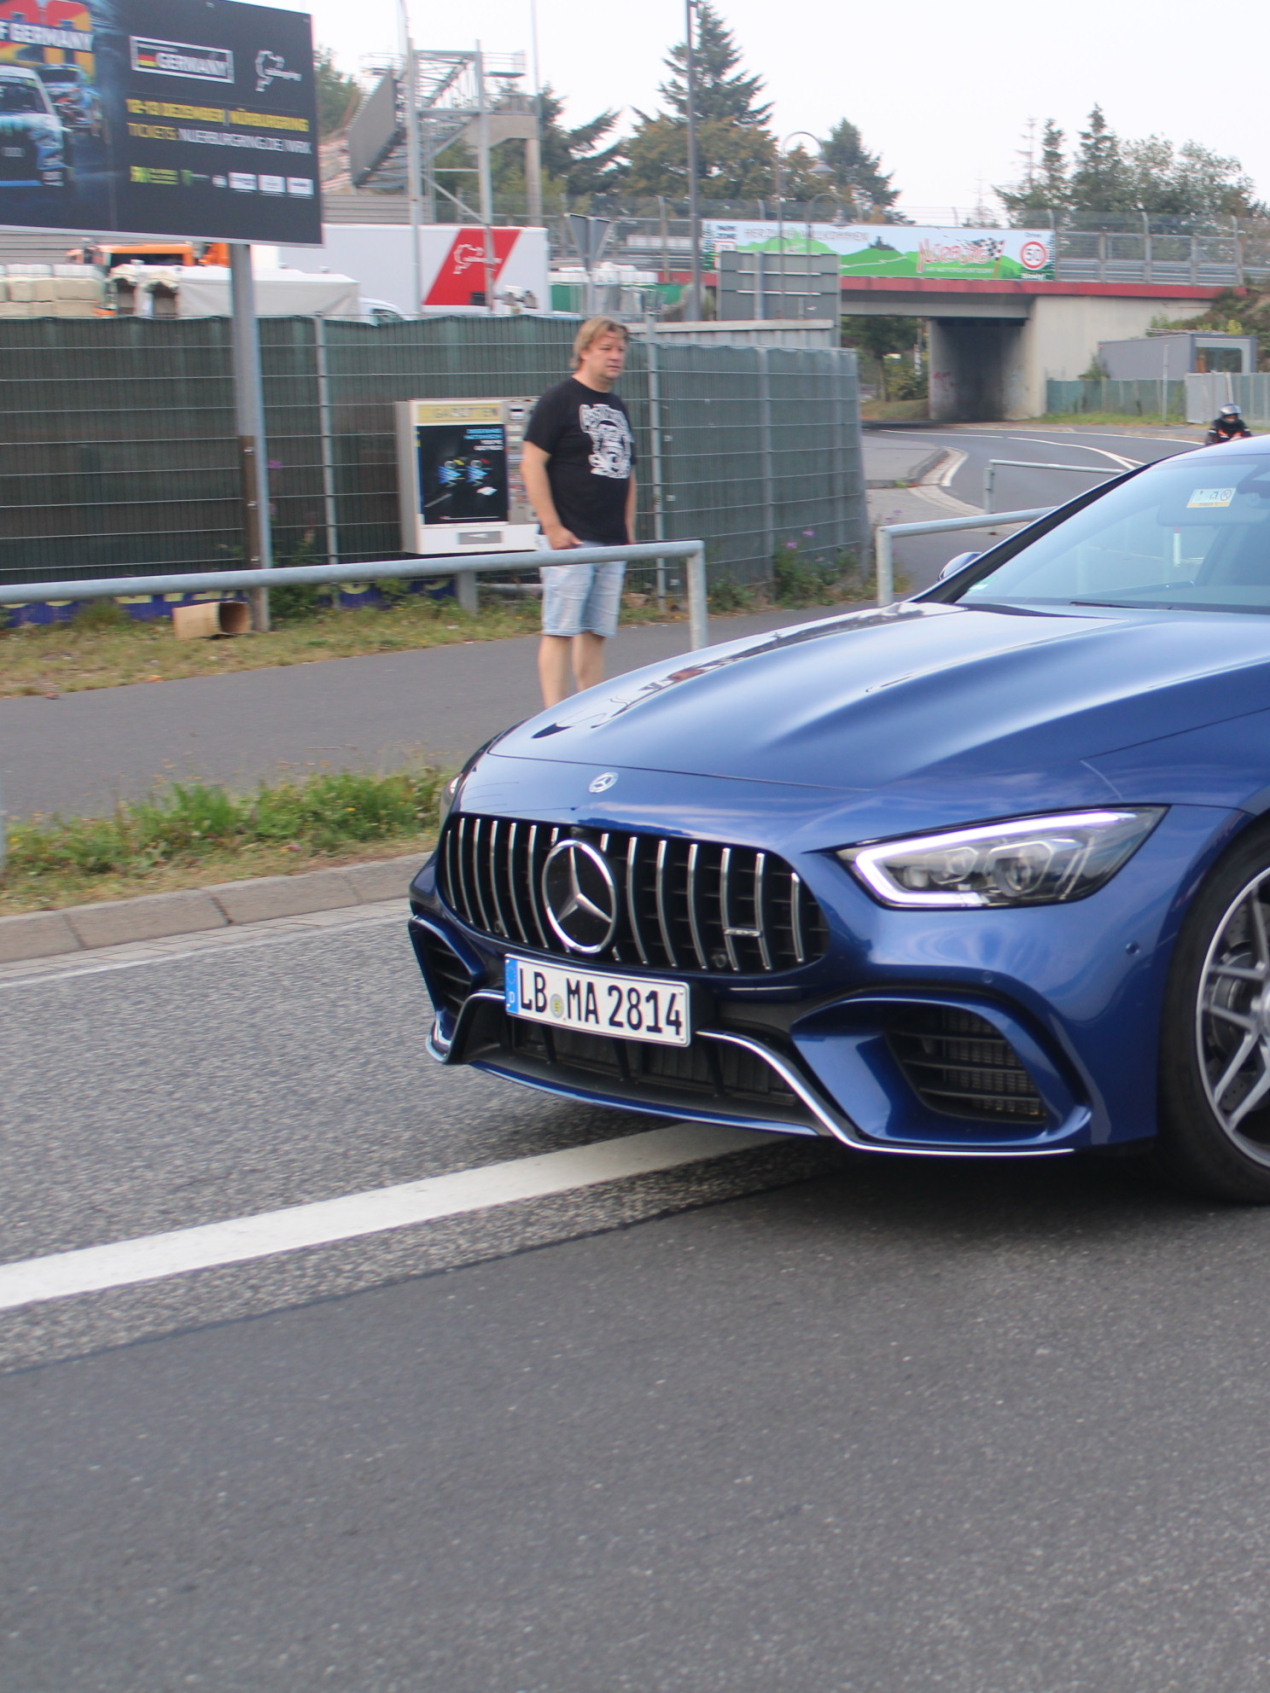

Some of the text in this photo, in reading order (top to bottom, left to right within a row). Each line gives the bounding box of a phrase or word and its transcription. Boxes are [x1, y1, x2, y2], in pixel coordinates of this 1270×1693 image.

[9, 22, 94, 51] GERMANY
[156, 52, 228, 77] GERMANY
[229, 107, 310, 132] NÜRBURGRING
[519, 967, 548, 1013] LB
[565, 978, 600, 1024] MA
[607, 984, 683, 1037] 2814
